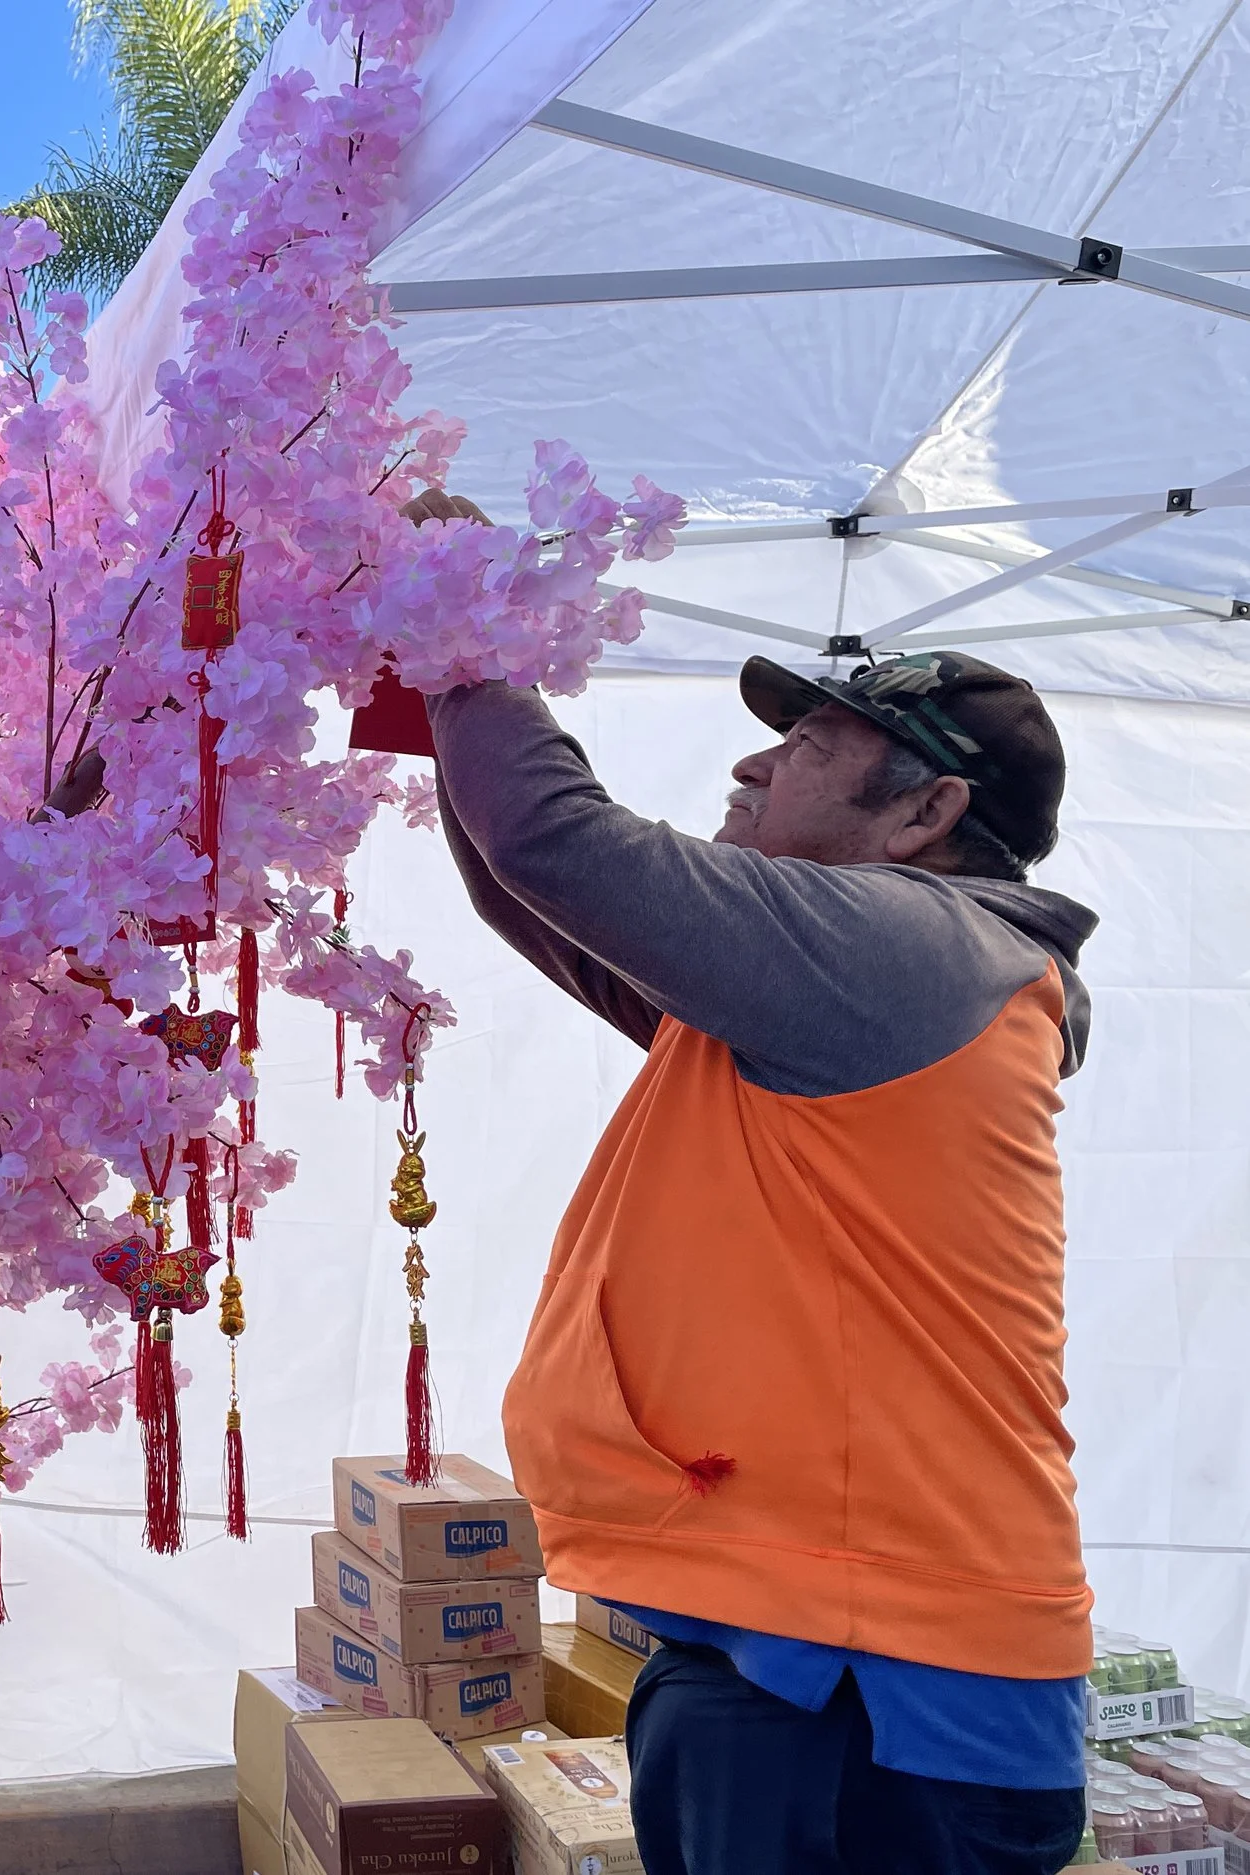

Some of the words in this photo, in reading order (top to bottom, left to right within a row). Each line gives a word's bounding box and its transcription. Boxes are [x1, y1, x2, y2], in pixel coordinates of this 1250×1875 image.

[353, 1488, 374, 1520] CALPICO
[450, 1527, 502, 1545] CALPICO
[341, 1569, 369, 1602] CALPICO
[448, 1608, 498, 1629] CALPICO
[337, 1643, 374, 1680] CALPICO
[464, 1679, 508, 1704] CALPICO
[1099, 1703, 1137, 1720] SANZO
[361, 1855, 393, 1870] Cha
[398, 1846, 453, 1867] Juroku
